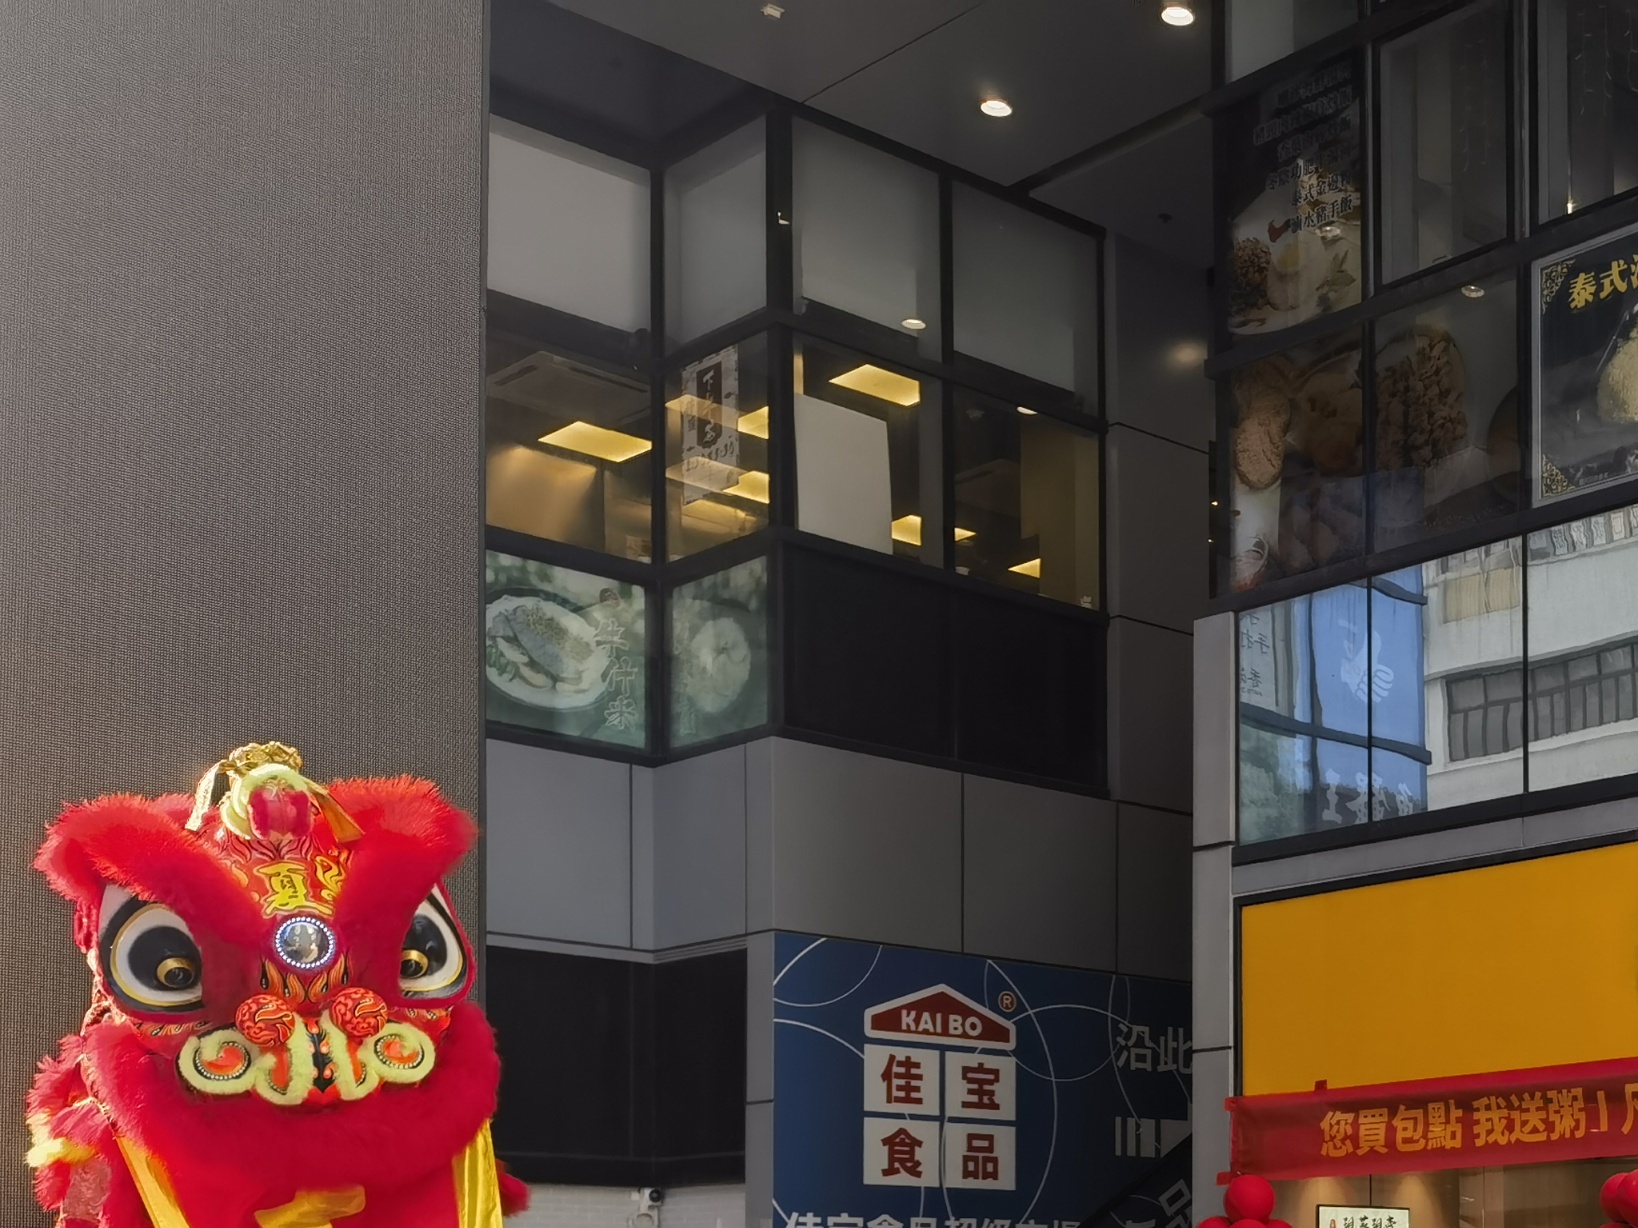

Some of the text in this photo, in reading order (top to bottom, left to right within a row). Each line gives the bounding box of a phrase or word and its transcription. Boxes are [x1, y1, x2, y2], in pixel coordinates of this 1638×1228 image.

[253, 860, 337, 916] 夏
[900, 1009, 983, 1037] KAI BO
[1116, 1023, 1192, 1075] 沿此
[880, 1054, 1001, 1111] 佳宝
[1319, 1104, 1463, 1159] 您買包點
[1472, 1087, 1586, 1147] 我送粥
[880, 1127, 1000, 1182] 食品
